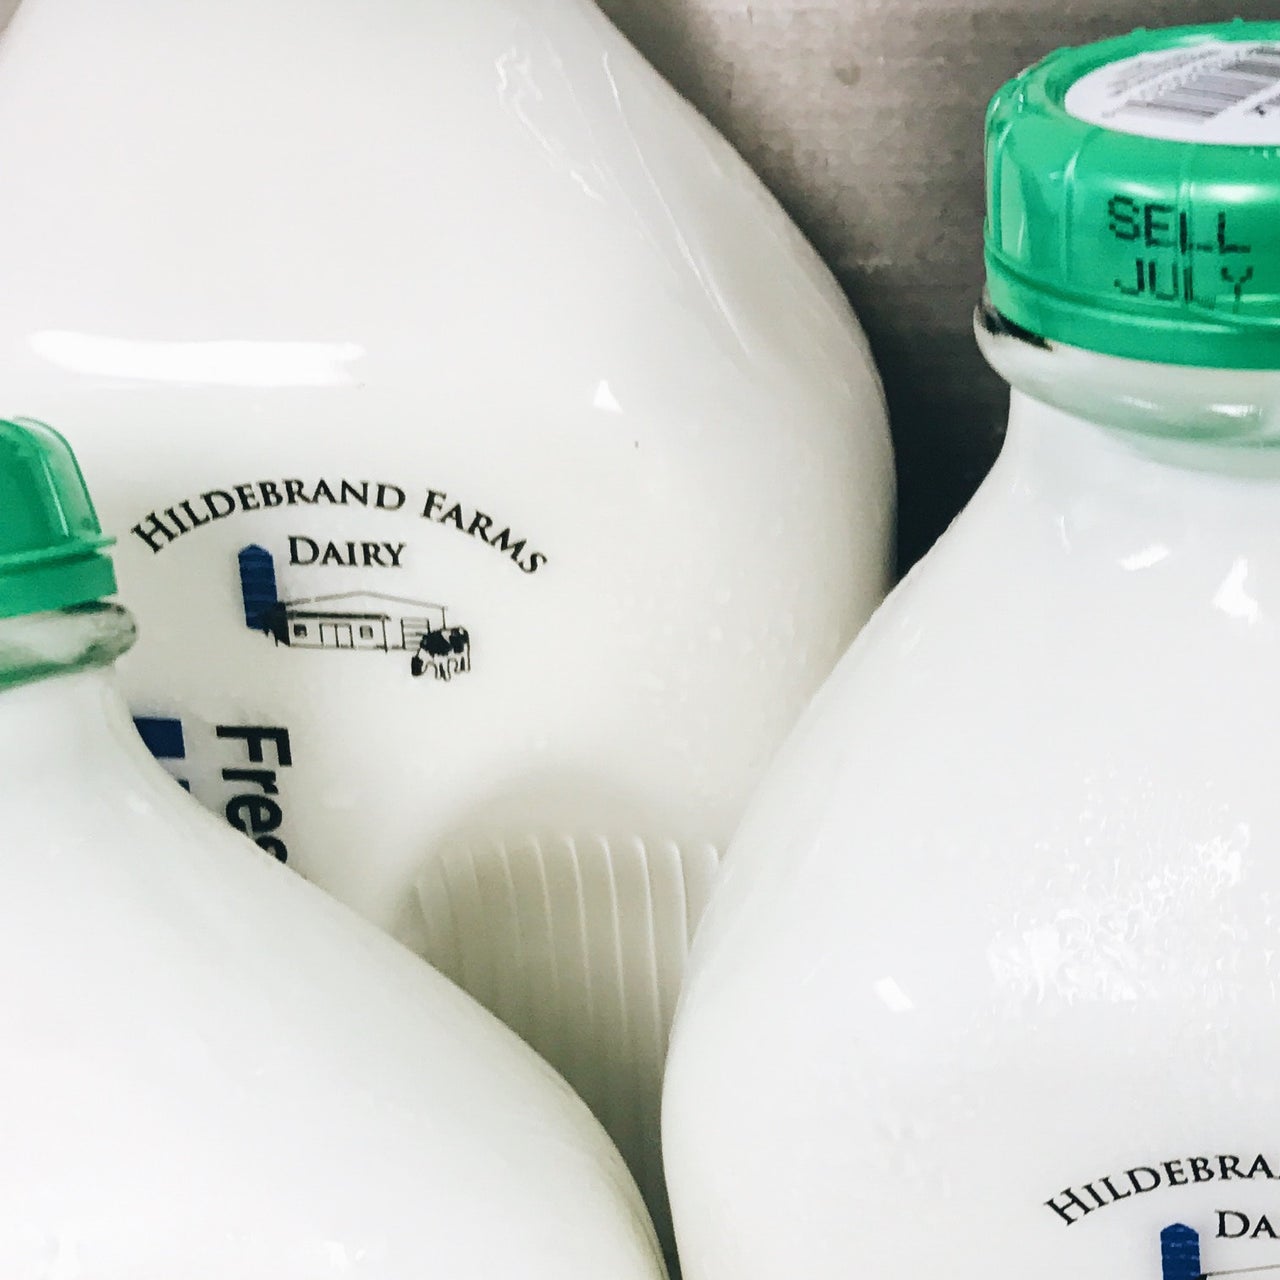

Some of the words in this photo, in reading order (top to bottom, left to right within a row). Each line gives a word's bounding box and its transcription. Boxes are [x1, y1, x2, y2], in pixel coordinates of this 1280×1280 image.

[1108, 194, 1251, 255] SELL
[1113, 259, 1253, 312] JULY
[131, 478, 406, 554] HILDEBRAND
[420, 489, 548, 575] FARMS
[287, 535, 405, 568] DAIRY
